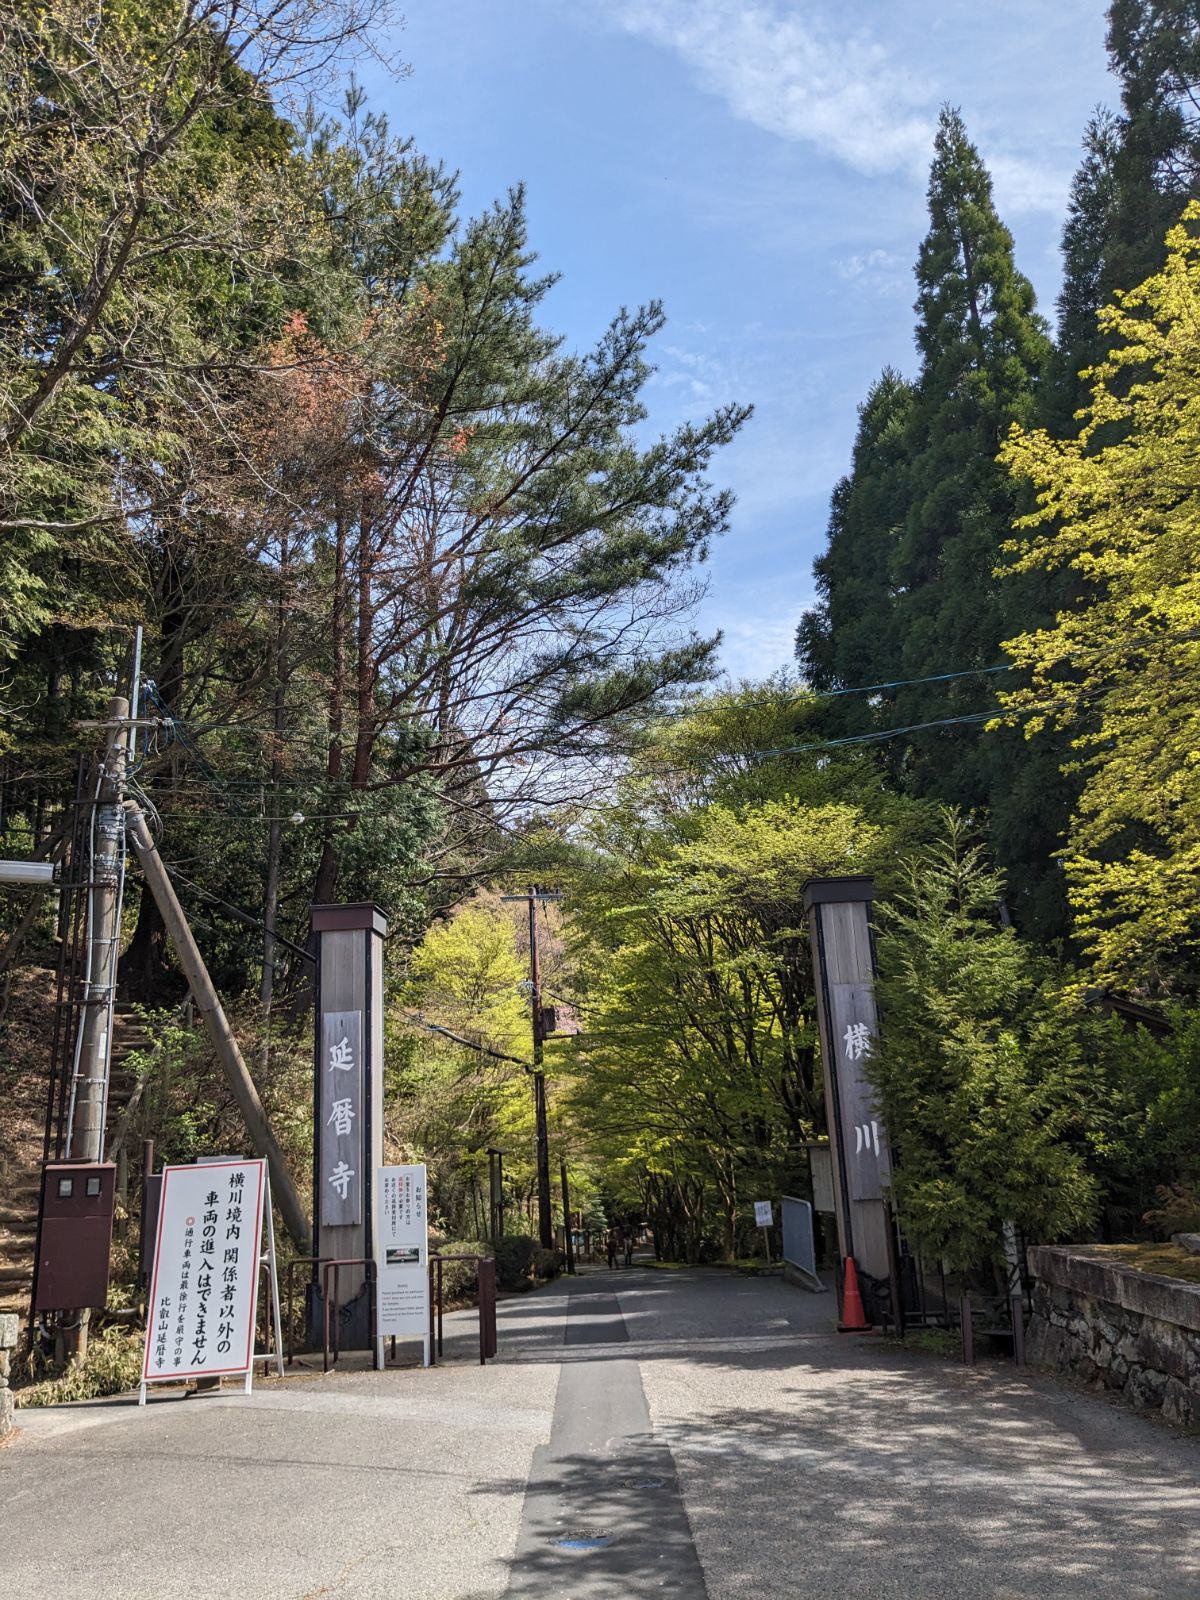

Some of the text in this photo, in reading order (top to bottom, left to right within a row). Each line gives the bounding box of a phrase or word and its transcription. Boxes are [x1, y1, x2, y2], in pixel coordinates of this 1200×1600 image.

[326, 1036, 356, 1200] 延暦寺
[843, 1022, 880, 1157] 横川
[155, 1296, 171, 1368] 比叡山延暦寺
[190, 1190, 220, 1366] 車両の進入はできません
